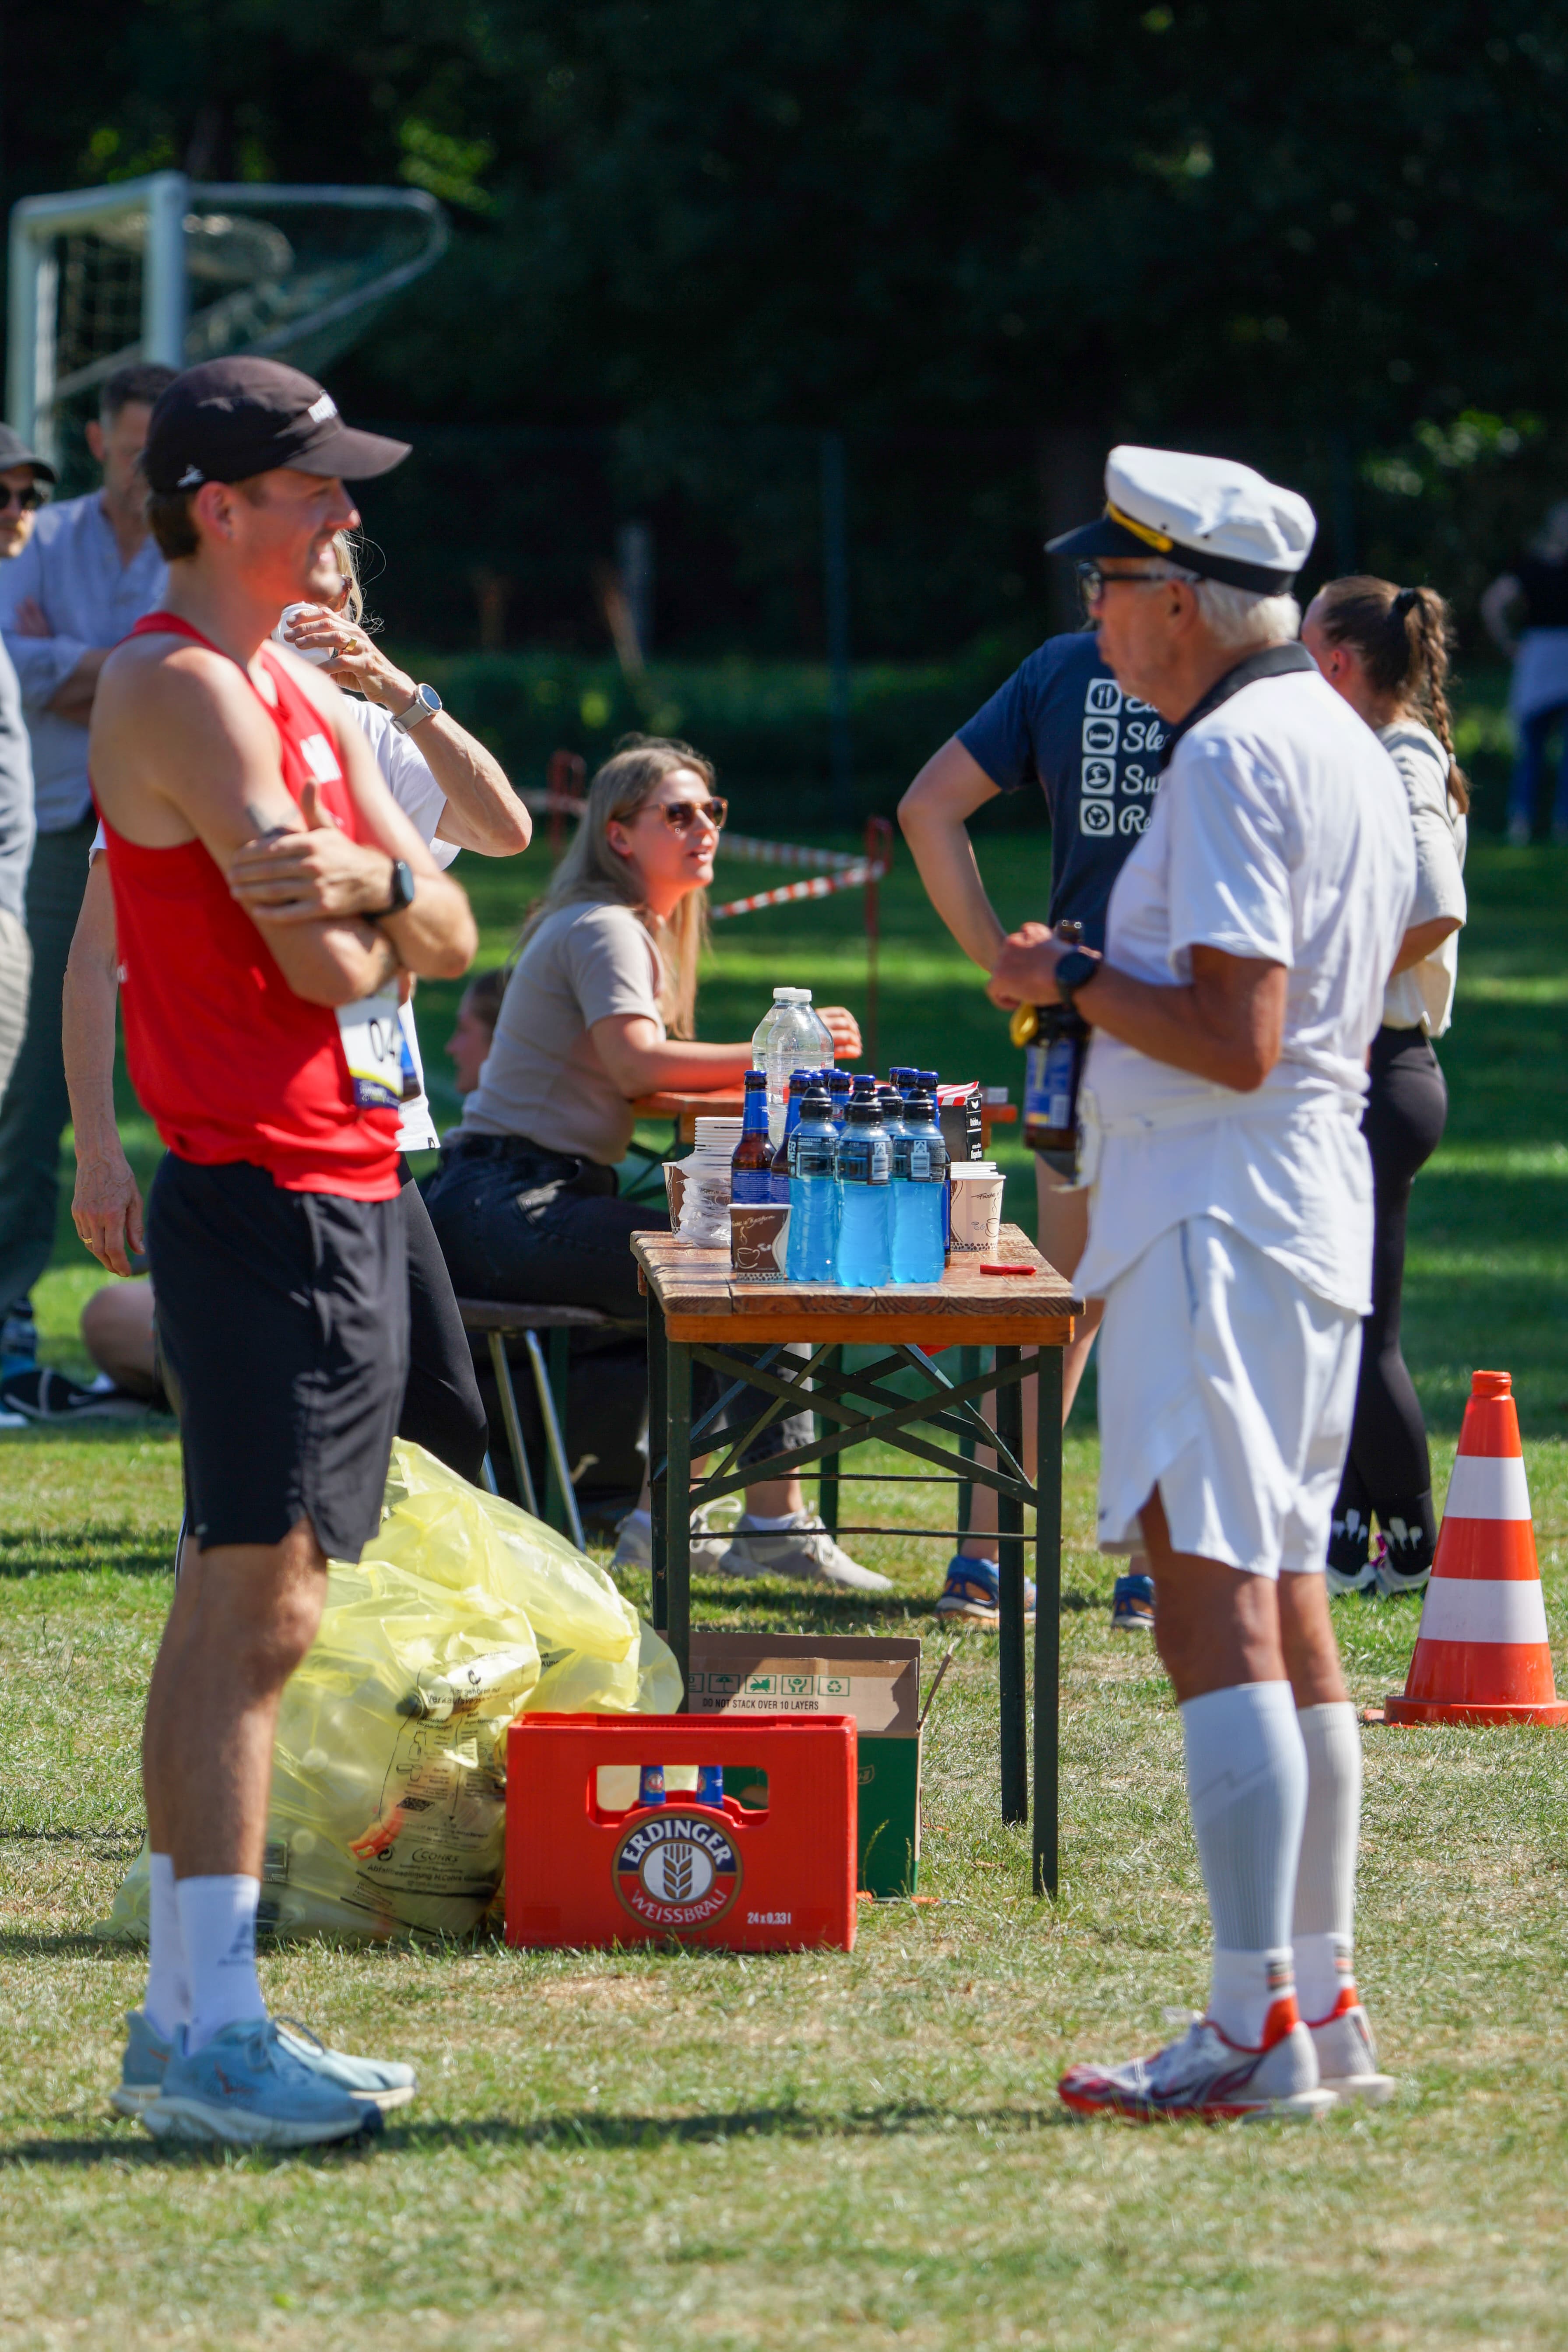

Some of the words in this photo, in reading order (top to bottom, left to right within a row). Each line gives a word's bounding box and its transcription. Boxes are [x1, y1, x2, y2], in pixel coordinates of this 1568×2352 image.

[1121, 720, 1171, 752] Sle
[1118, 805, 1152, 835] Re
[703, 1698, 713, 1707] DO
[715, 1698, 730, 1708] NOT
[732, 1699, 756, 1709] STACK
[758, 1700, 777, 1709] OVER
[780, 1701, 788, 1709] 10
[791, 1701, 819, 1710] LAYERS
[622, 1820, 732, 1865] ERDINGER
[747, 1912, 759, 1924] 24
